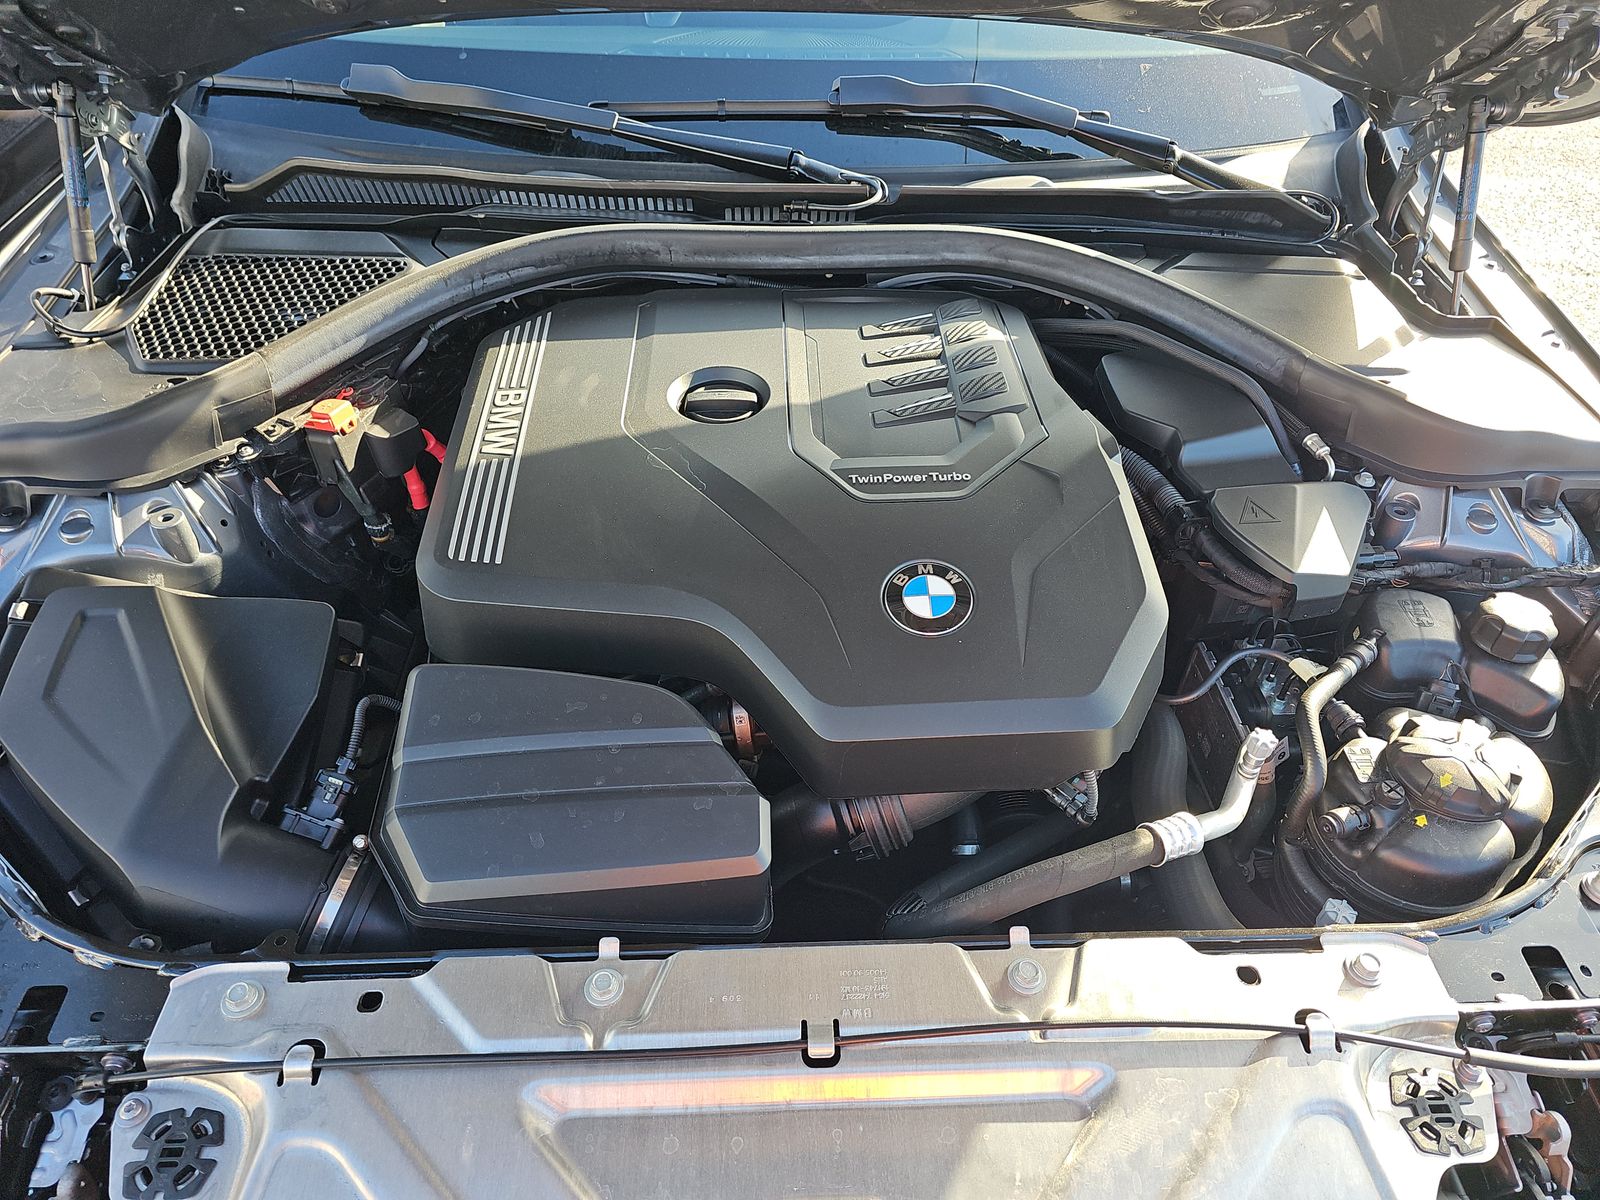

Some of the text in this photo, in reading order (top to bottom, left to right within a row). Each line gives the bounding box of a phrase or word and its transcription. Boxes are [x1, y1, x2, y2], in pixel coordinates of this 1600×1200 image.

[480, 388, 529, 457] BMW
[848, 471, 972, 484] TwinPower Turbo
[893, 564, 963, 587] BMW
[842, 1008, 872, 1020] BMW
